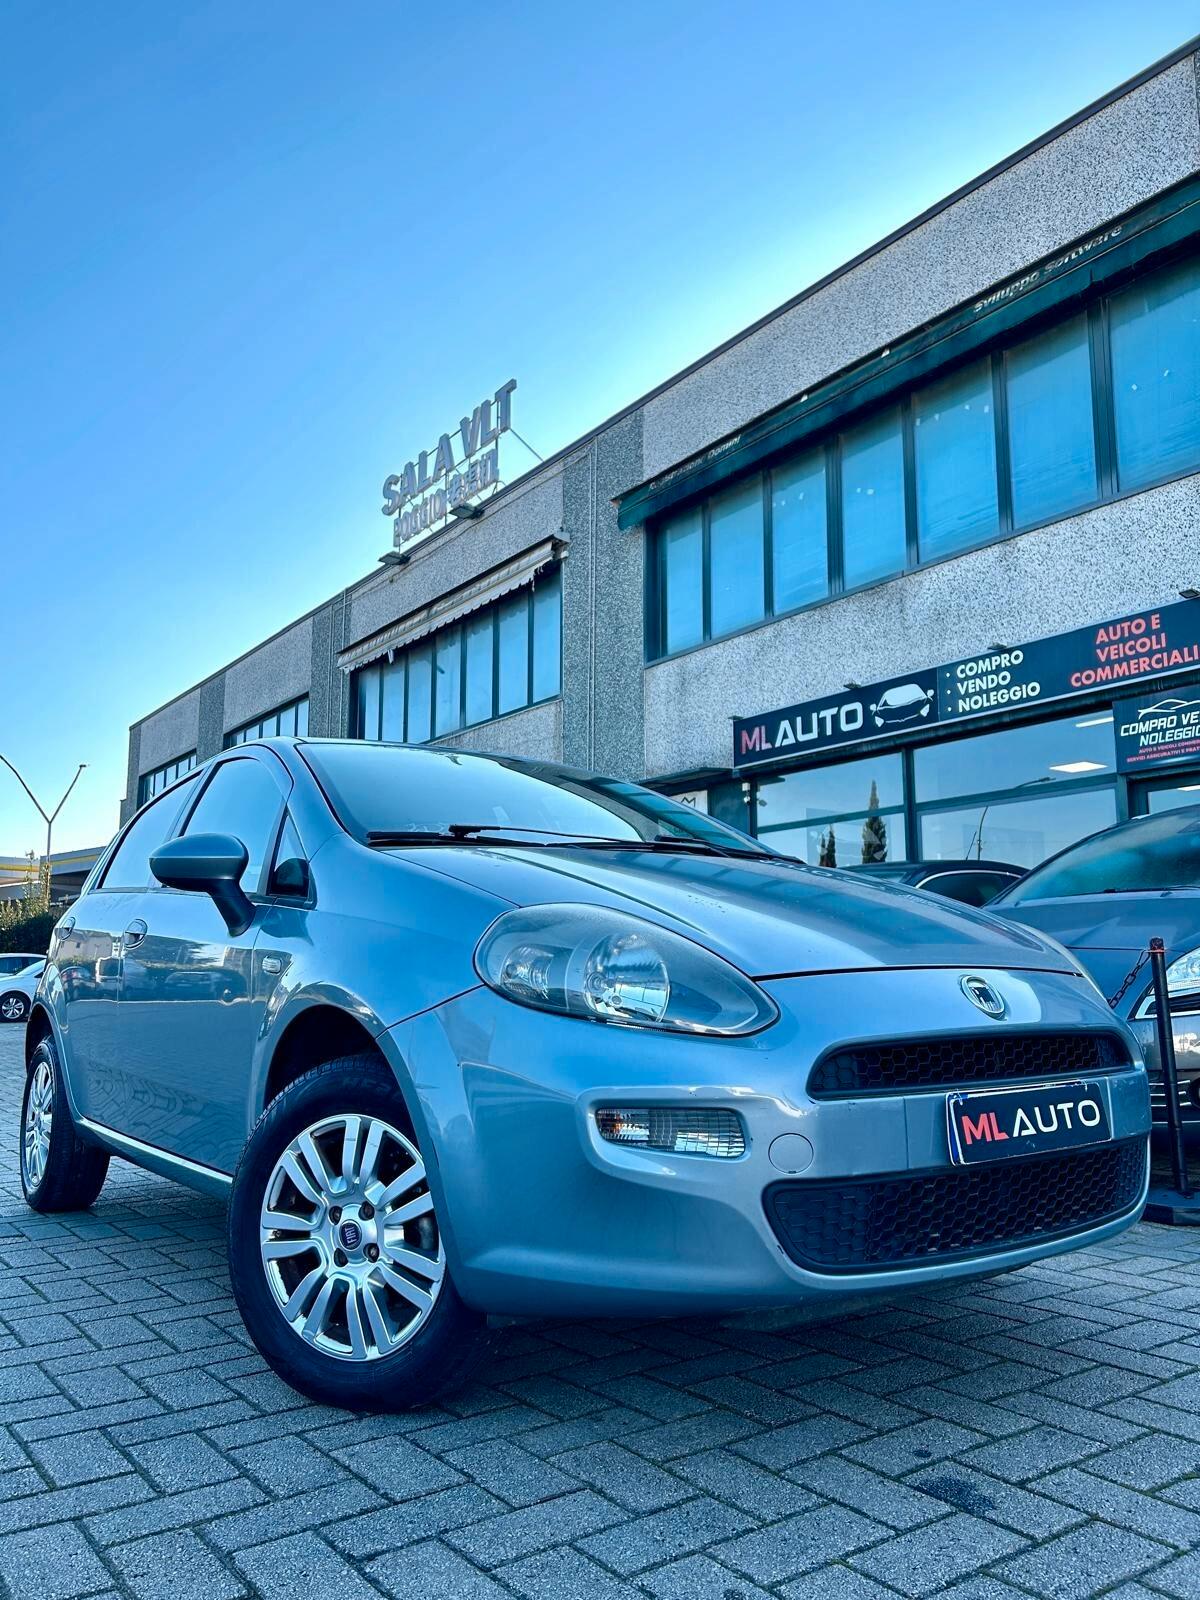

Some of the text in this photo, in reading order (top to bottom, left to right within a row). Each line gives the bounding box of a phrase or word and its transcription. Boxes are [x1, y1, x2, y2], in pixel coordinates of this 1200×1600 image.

[382, 378, 517, 516] SALA VLT
[1095, 613, 1161, 645] AUTO E
[1096, 632, 1167, 663] VEICOLI
[956, 650, 1024, 679] COMPRO
[1070, 644, 1199, 687] COMMERCIALI
[957, 671, 1011, 696] VENDO
[958, 682, 1041, 712] NOLEGGIO
[1120, 716, 1177, 736] COMPRO
[344, 1225, 358, 1245] FIAT
